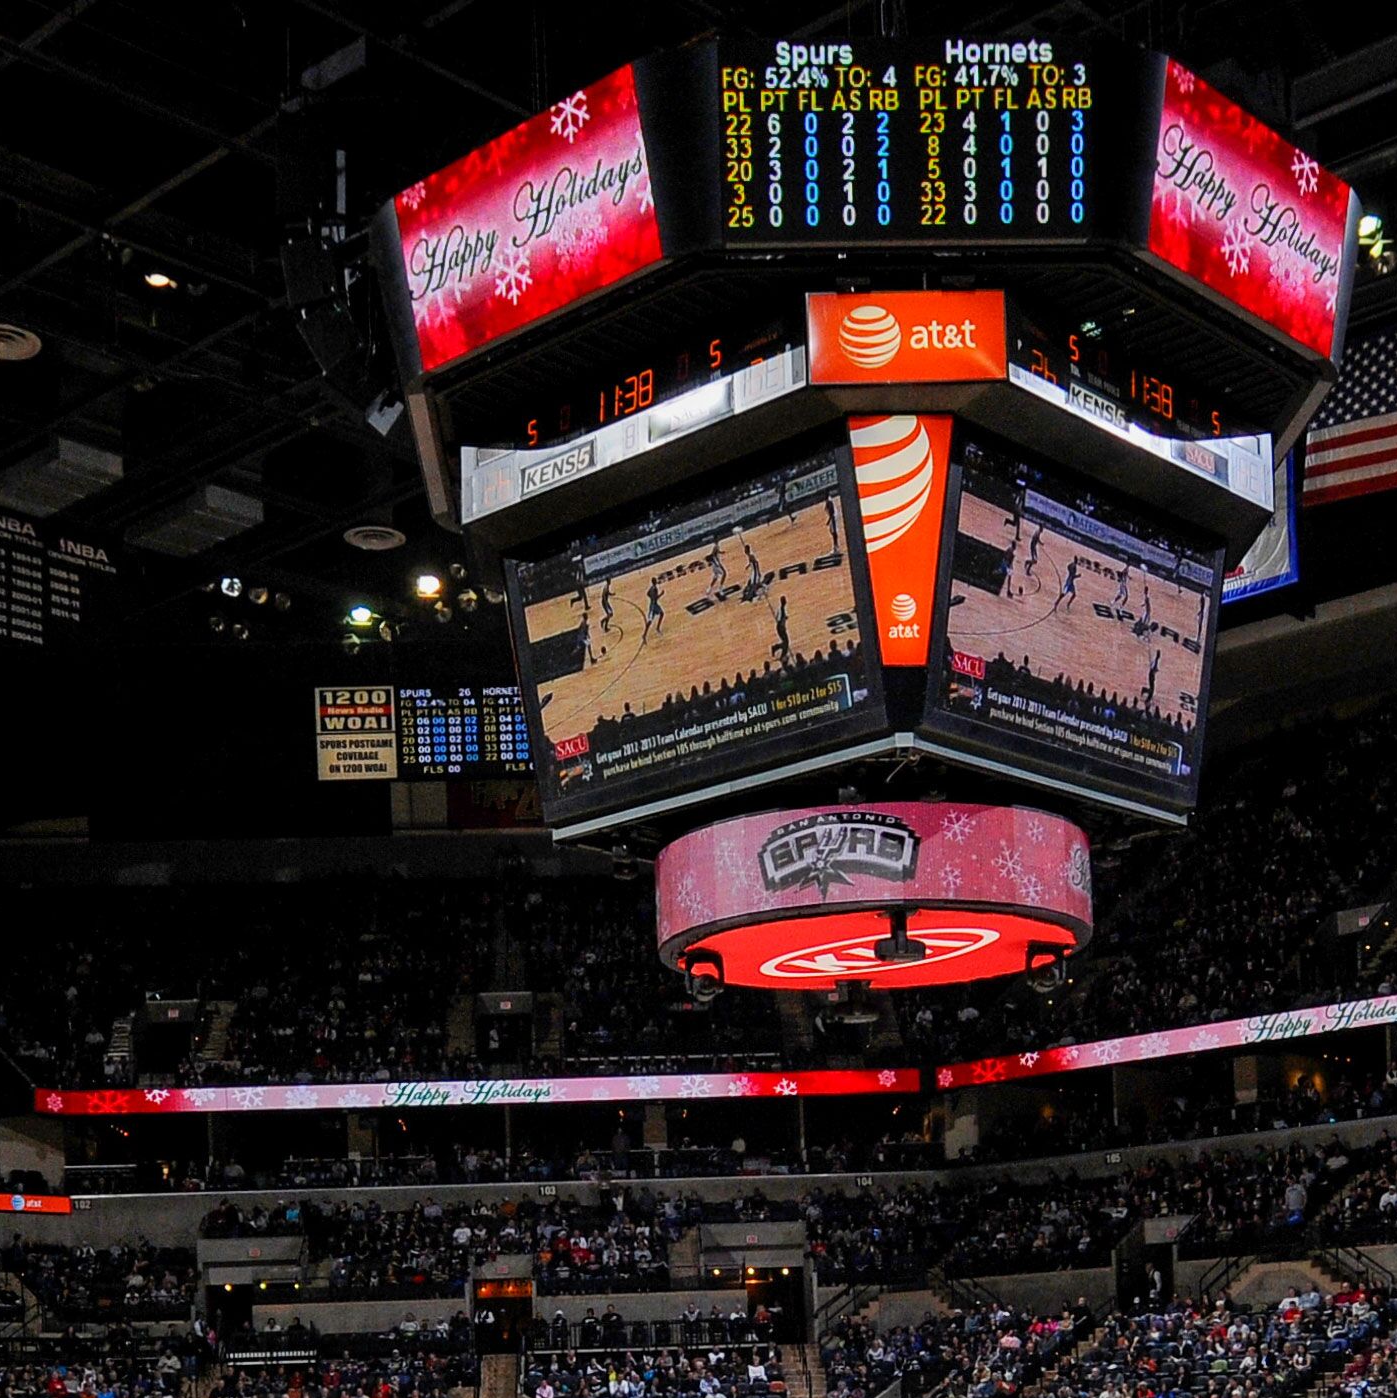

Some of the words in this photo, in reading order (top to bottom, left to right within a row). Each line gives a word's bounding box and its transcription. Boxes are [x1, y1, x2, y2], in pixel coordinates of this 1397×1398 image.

[775, 41, 853, 66] Spurs
[945, 39, 1053, 64] Hornets
[722, 67, 755, 89] FG:
[765, 66, 829, 89] 52.4%
[834, 66, 872, 88] TO:
[882, 66, 897, 88] 4
[914, 65, 948, 87] FG:
[953, 64, 1019, 87] 41.7%
[1028, 64, 1066, 86] TO:
[1073, 64, 1086, 86] 3
[722, 90, 752, 112] PL
[760, 90, 789, 112] PT
[798, 90, 824, 112] FL
[831, 89, 862, 111] AS
[869, 89, 900, 111] RB
[919, 89, 948, 111] PL
[956, 88, 985, 110] PT
[994, 88, 1019, 110] FL
[1026, 87, 1057, 109] AS
[1062, 87, 1093, 109] RB
[726, 113, 752, 136] 22
[767, 113, 781, 135] 6
[804, 113, 818, 135] 0
[841, 112, 855, 134] 2
[876, 112, 890, 134] 2
[919, 111, 945, 134] 23
[962, 110, 977, 133] 4
[1000, 110, 1011, 132] 1
[1036, 110, 1050, 132] 0
[1071, 110, 1085, 132] 3
[1154, 124, 1236, 222] Happy
[1243, 183, 1338, 283] Holidays
[410, 225, 499, 301] Happy
[512, 148, 643, 249] Holidays
[909, 317, 977, 350] at&t
[598, 367, 655, 424] 11:38
[887, 622, 922, 640] at&t
[322, 689, 387, 706] 1200
[399, 689, 432, 698] SPURS
[458, 687, 472, 697] 26
[327, 706, 354, 716] News
[356, 705, 385, 715] Radio
[324, 716, 388, 730] WOAI
[319, 740, 346, 750] SPURS
[348, 738, 394, 750] POSTGAME
[557, 736, 588, 758] SACU
[336, 750, 379, 762] COVERAGE
[329, 764, 342, 774] ON
[342, 763, 363, 774] 1200
[364, 762, 388, 773] WOAI
[776, 821, 808, 836] SAN
[810, 813, 896, 828] ANTONIO
[1244, 1011, 1313, 1043] Happy
[381, 1079, 451, 1108] Happy
[455, 1078, 552, 1106] Holidays
[539, 1185, 557, 1196] 103
[855, 1175, 873, 1187] 104
